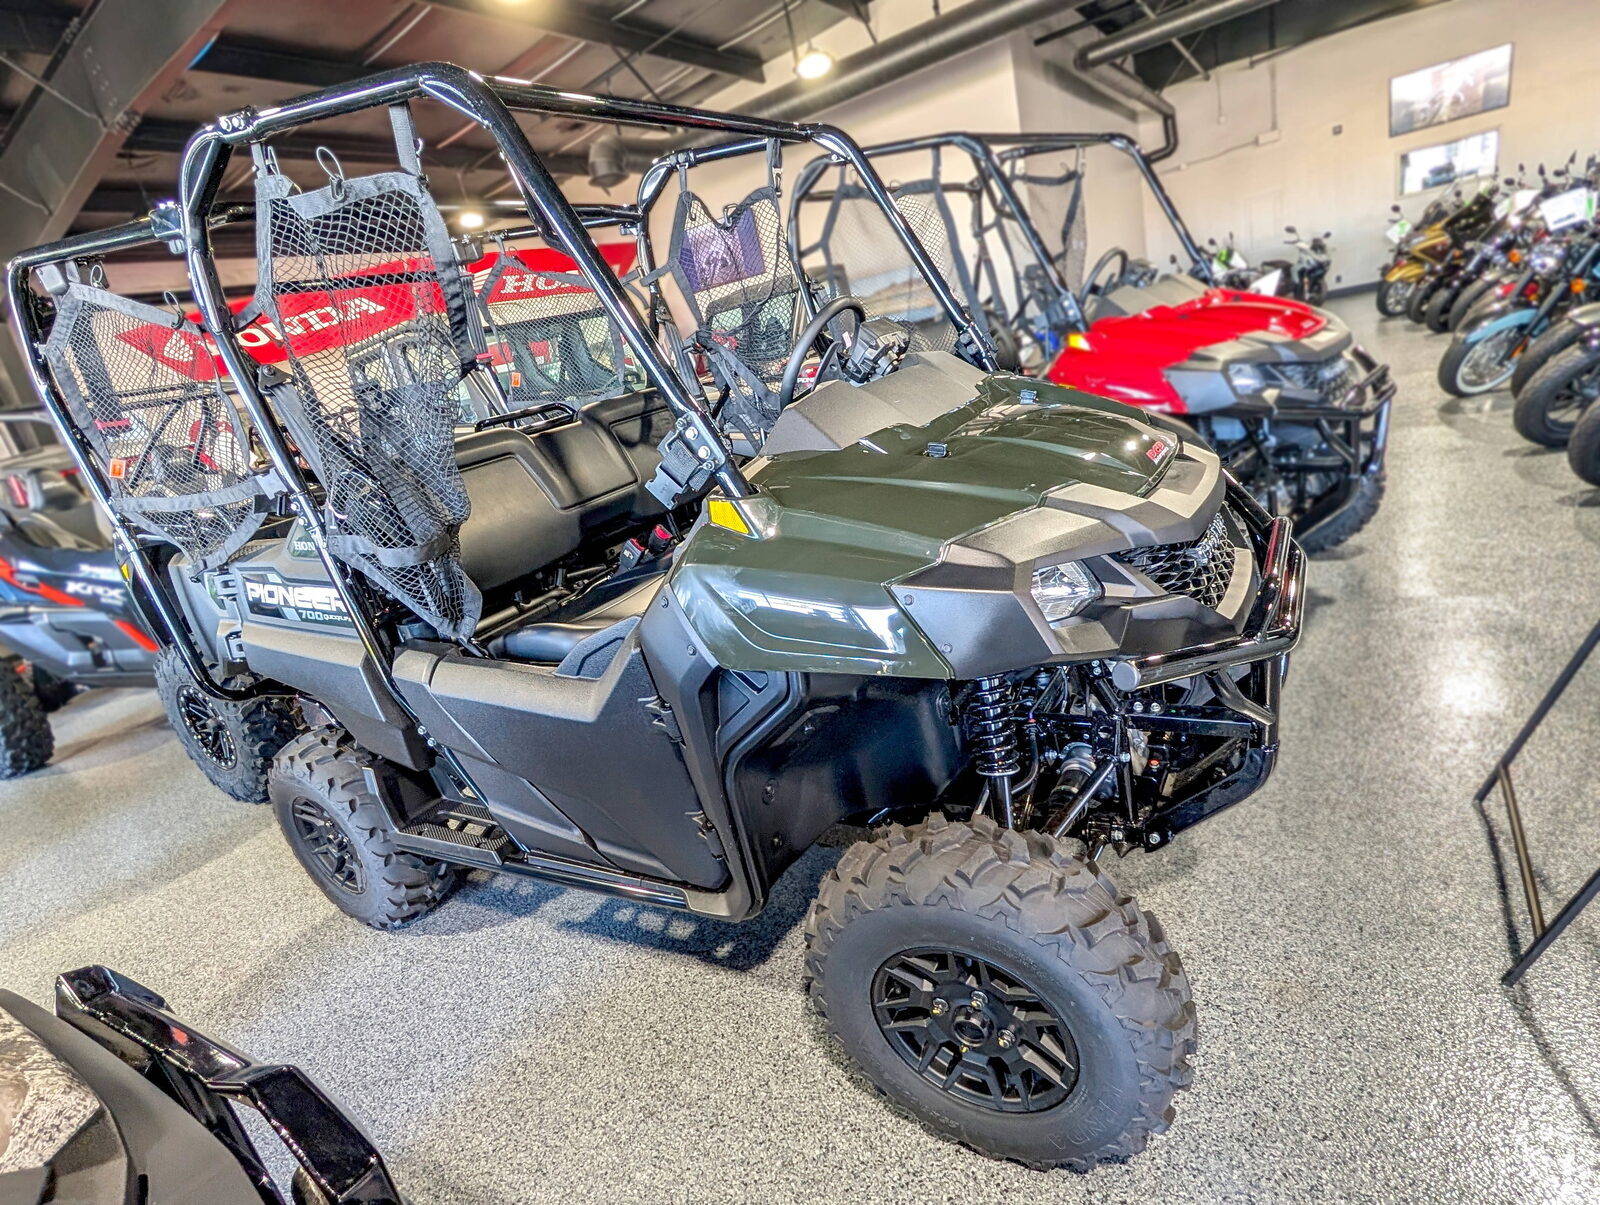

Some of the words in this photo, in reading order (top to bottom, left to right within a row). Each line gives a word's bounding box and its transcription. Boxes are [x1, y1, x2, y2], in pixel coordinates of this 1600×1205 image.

[294, 541, 317, 551] HON
[245, 582, 348, 612] PIONEER
[298, 609, 324, 621] 700
